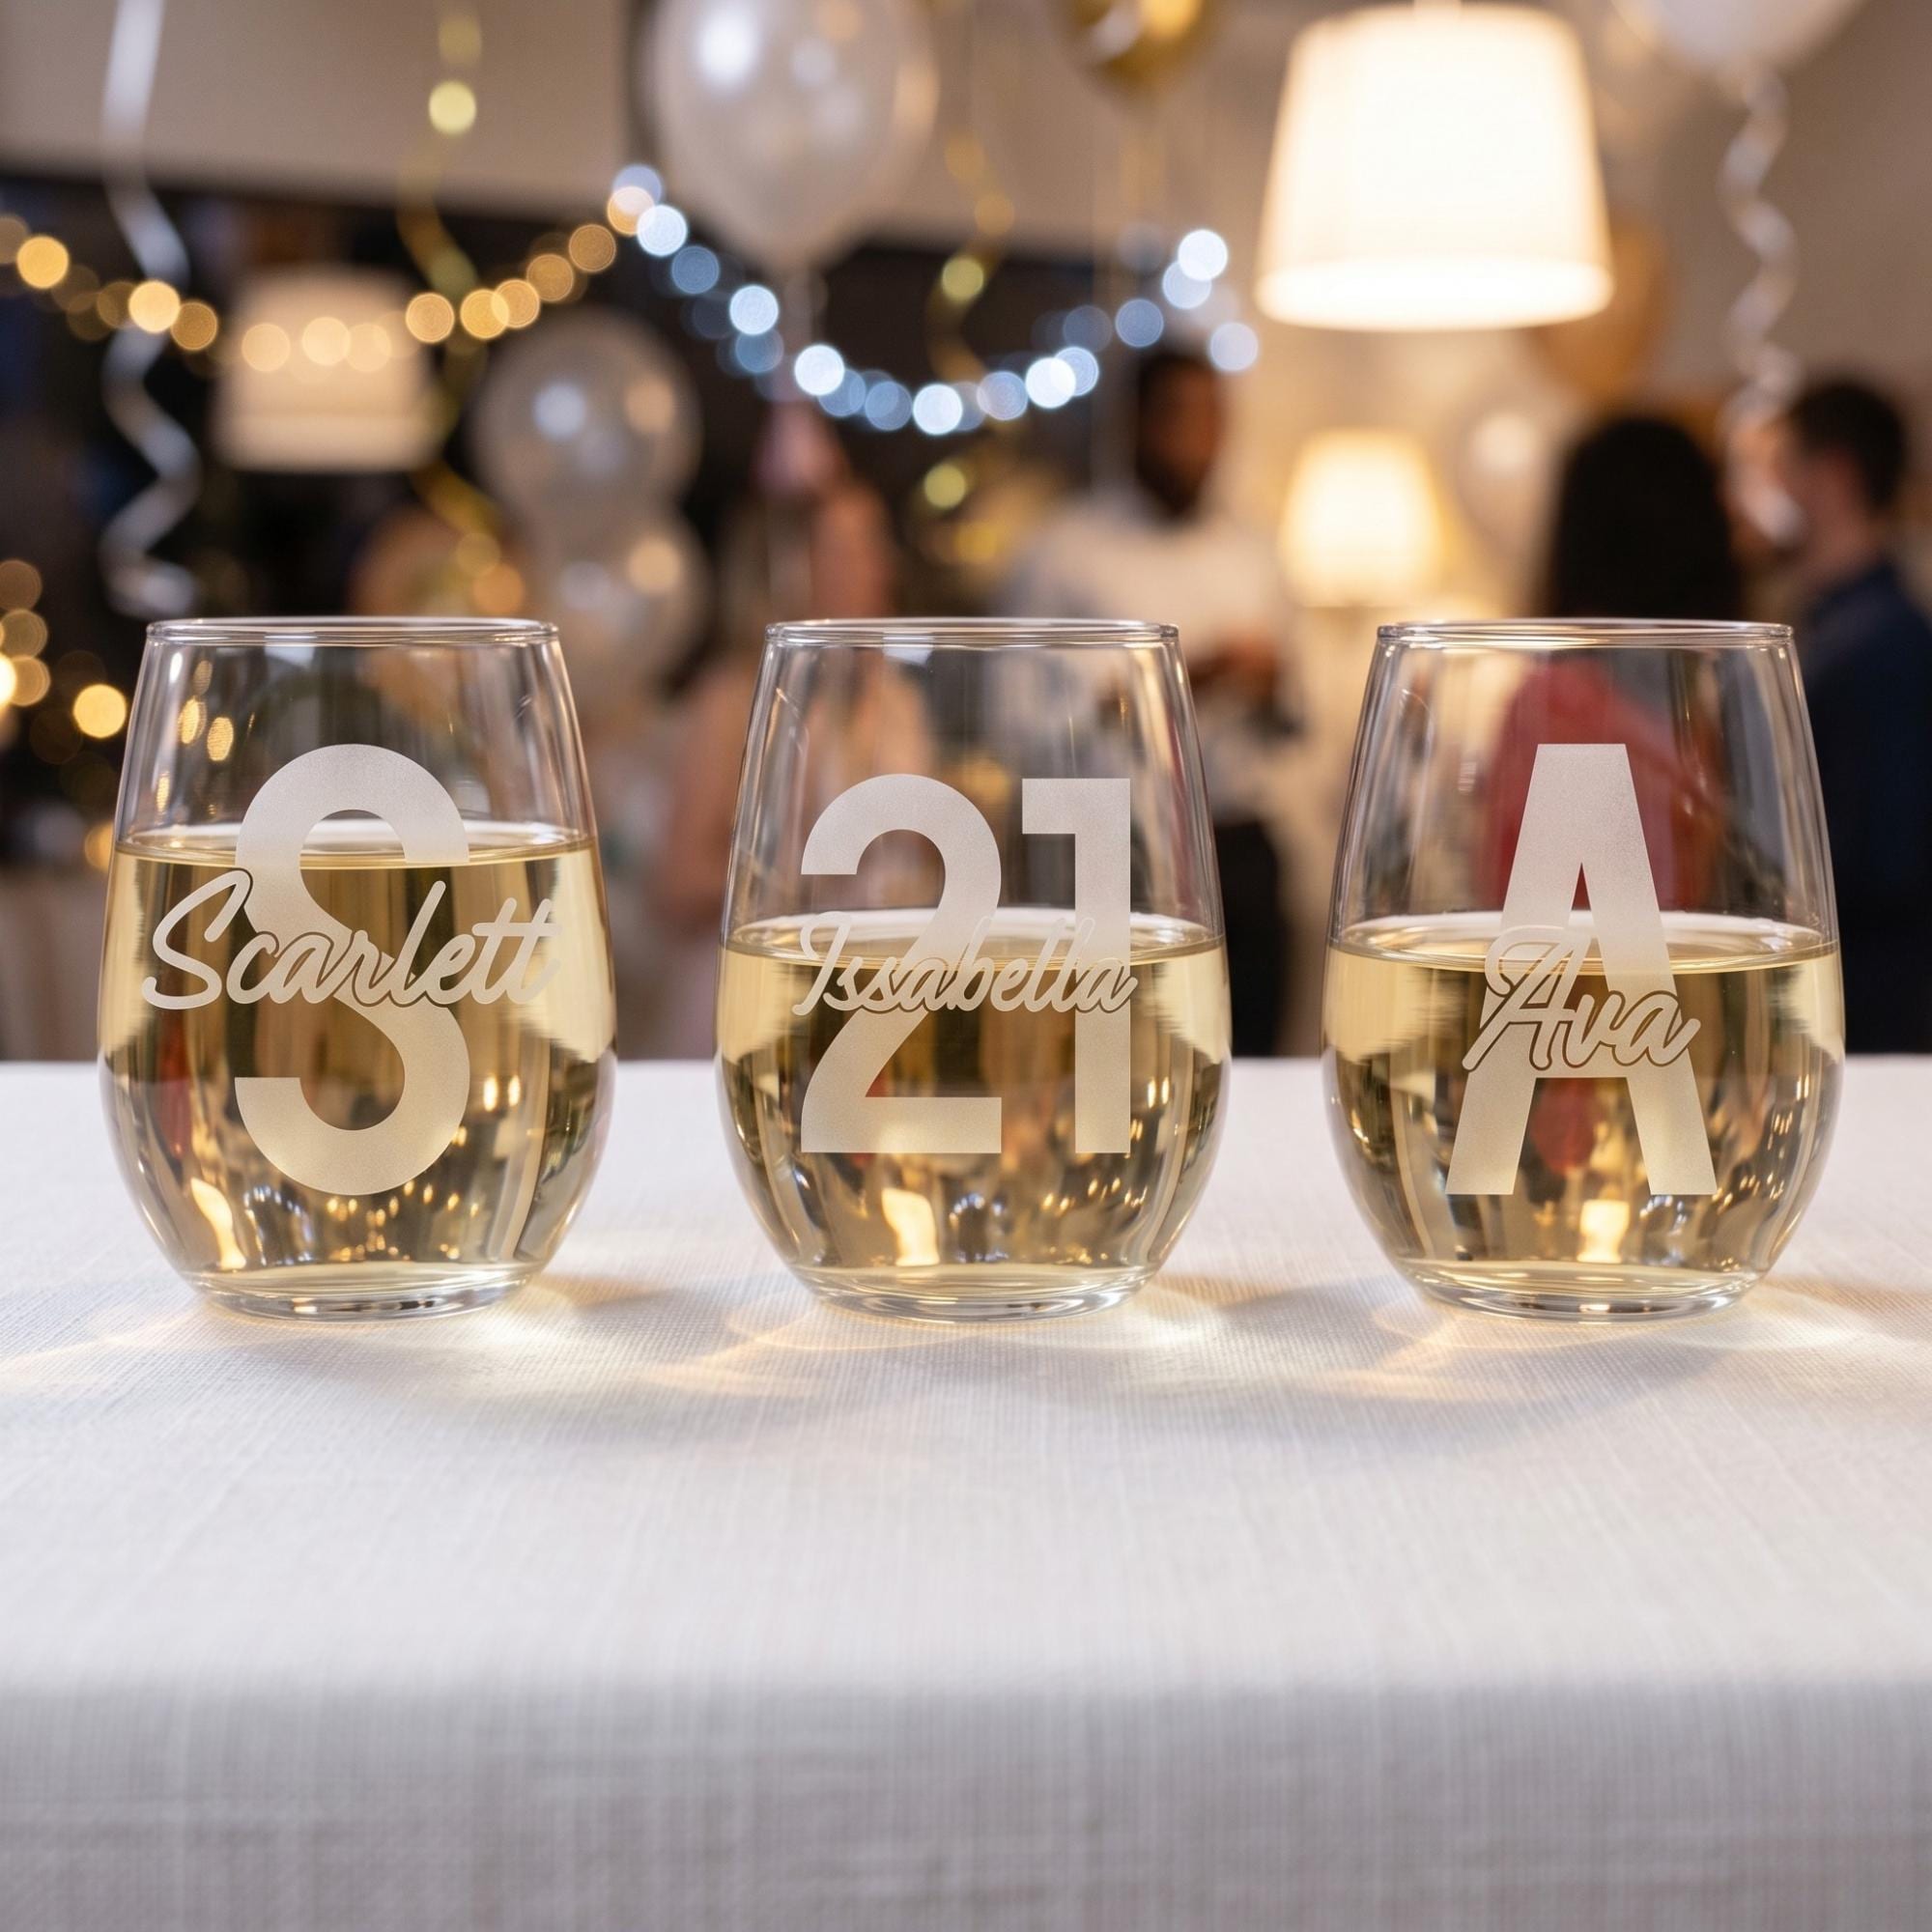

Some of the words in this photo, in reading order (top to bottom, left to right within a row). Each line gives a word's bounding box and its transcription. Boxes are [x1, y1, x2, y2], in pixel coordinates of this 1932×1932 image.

[142, 870, 562, 1010] Scarlett
[235, 743, 470, 1197] S
[800, 774, 1132, 1154] 21
[1445, 743, 1718, 1196] A
[1462, 924, 1702, 1071] Ava
